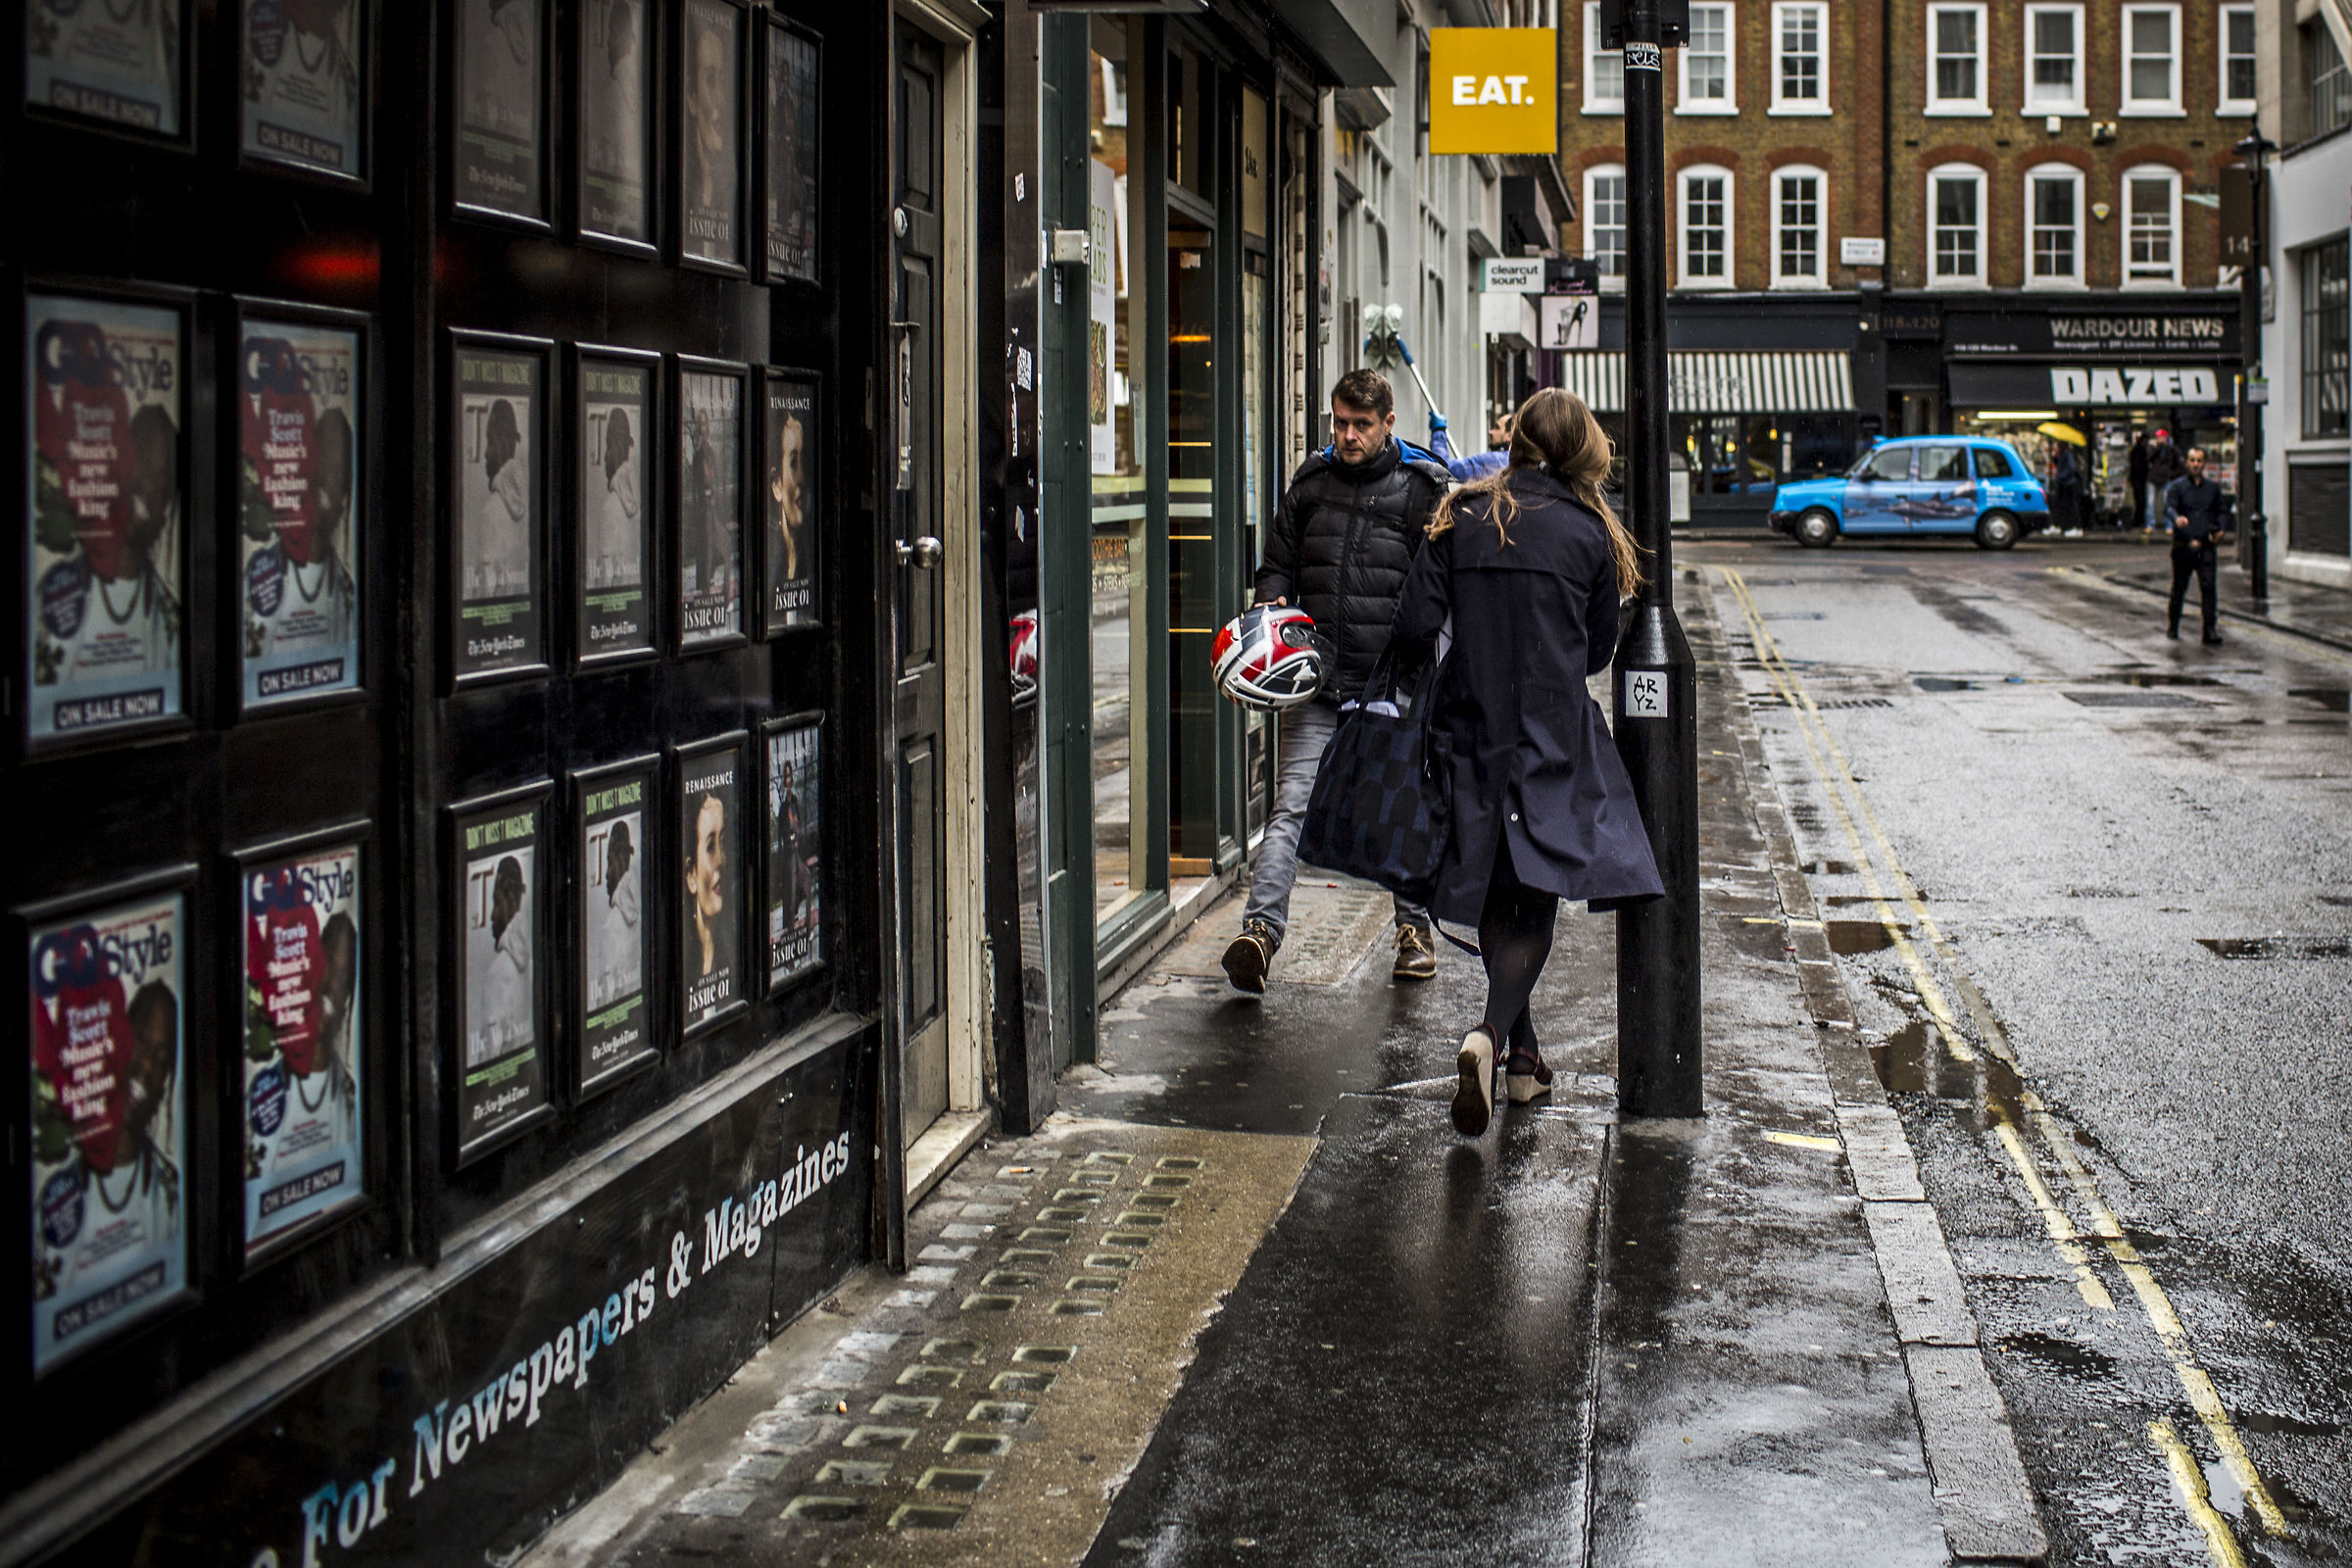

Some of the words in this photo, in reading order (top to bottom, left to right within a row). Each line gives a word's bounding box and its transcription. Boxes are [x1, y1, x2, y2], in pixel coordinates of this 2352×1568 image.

[1452, 75, 1535, 106] EAT.
[280, 130, 310, 156] SALE
[311, 139, 341, 165] NOW
[2228, 235, 2250, 254] 14
[1092, 249, 1107, 284] ADS
[1492, 266, 1539, 274] clearcut
[1492, 274, 1527, 285] sound
[2050, 318, 2158, 337] WARDOUR
[2163, 318, 2224, 337] NEWS
[108, 342, 173, 402] Style
[297, 354, 349, 408] Style
[2050, 367, 2220, 405] DAZED
[770, 396, 809, 411] RENAISSANCE
[264, 475, 309, 494] fashion
[76, 498, 110, 520] king
[271, 493, 302, 513] king
[775, 586, 798, 612] issue
[799, 589, 809, 606] 01
[685, 603, 712, 629] issue
[713, 606, 725, 624] 01
[260, 672, 280, 694] ON
[281, 667, 311, 690] SALE
[312, 662, 343, 684] NOW
[1634, 675, 1658, 694] AR
[59, 704, 83, 728] ON
[84, 697, 122, 723] SALE
[123, 690, 160, 717] NOW
[685, 770, 733, 795] RENAISSANCE
[299, 861, 355, 912] Style
[103, 923, 173, 984] Style
[773, 943, 796, 968] issue
[797, 937, 807, 956] 01
[268, 989, 313, 1012] fashion
[688, 983, 715, 1013] issue
[716, 978, 730, 998] 01
[275, 1006, 306, 1027] king
[60, 1072, 117, 1106] fashion
[72, 1095, 108, 1122] king
[263, 1191, 281, 1216] ON
[281, 1179, 312, 1204] SALE
[312, 1165, 342, 1193] NOW
[58, 1309, 83, 1337] ON
[84, 1291, 125, 1326] SALE
[125, 1272, 162, 1301] NOW
[302, 1455, 395, 1568] For
[408, 1264, 657, 1497] Newspapers
[665, 1231, 692, 1299] &
[701, 1129, 851, 1275] Magazines
